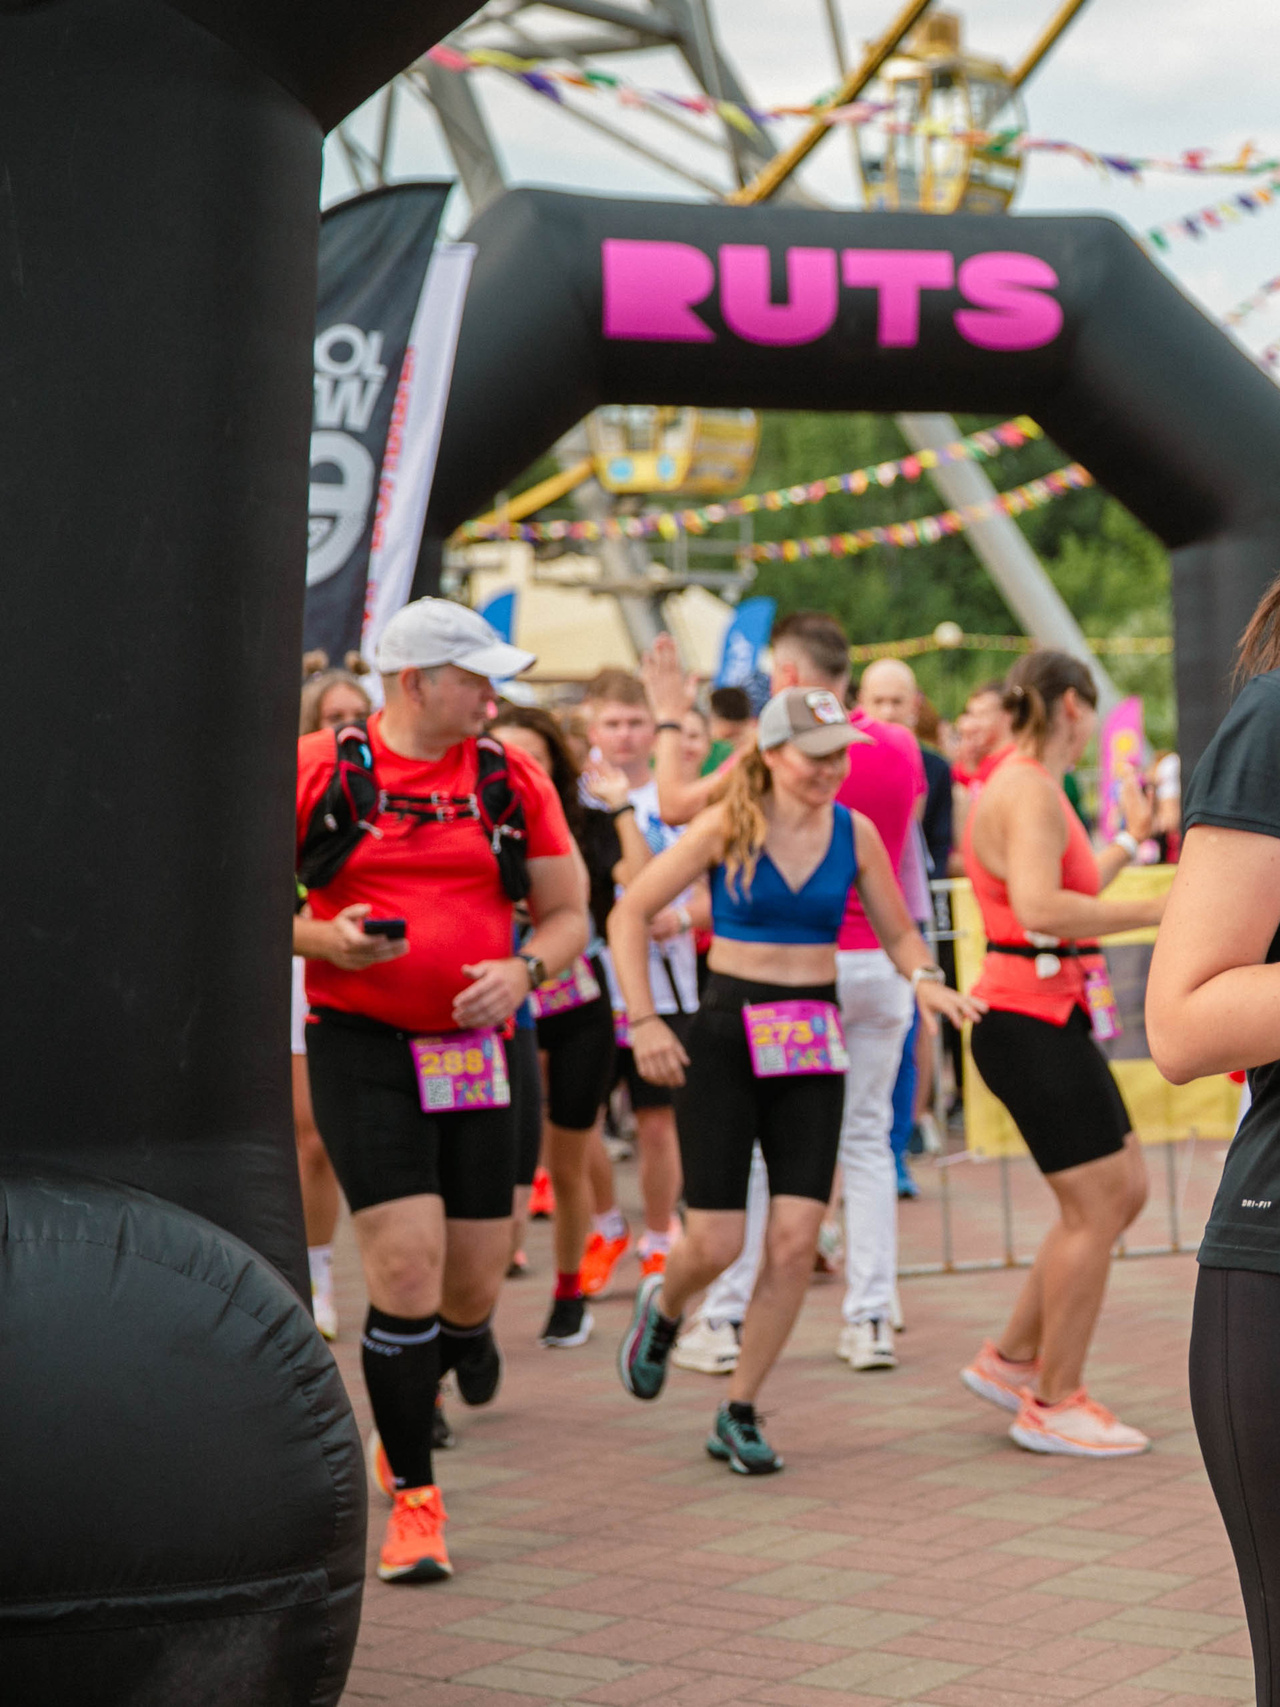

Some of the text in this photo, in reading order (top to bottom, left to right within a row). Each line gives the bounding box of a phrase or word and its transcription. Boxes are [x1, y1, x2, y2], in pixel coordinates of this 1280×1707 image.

[602, 237, 1065, 352] RUTS
[751, 1021, 814, 1047] 273
[419, 1048, 485, 1077] 288
[1241, 1199, 1272, 1210] DRI-FIT
